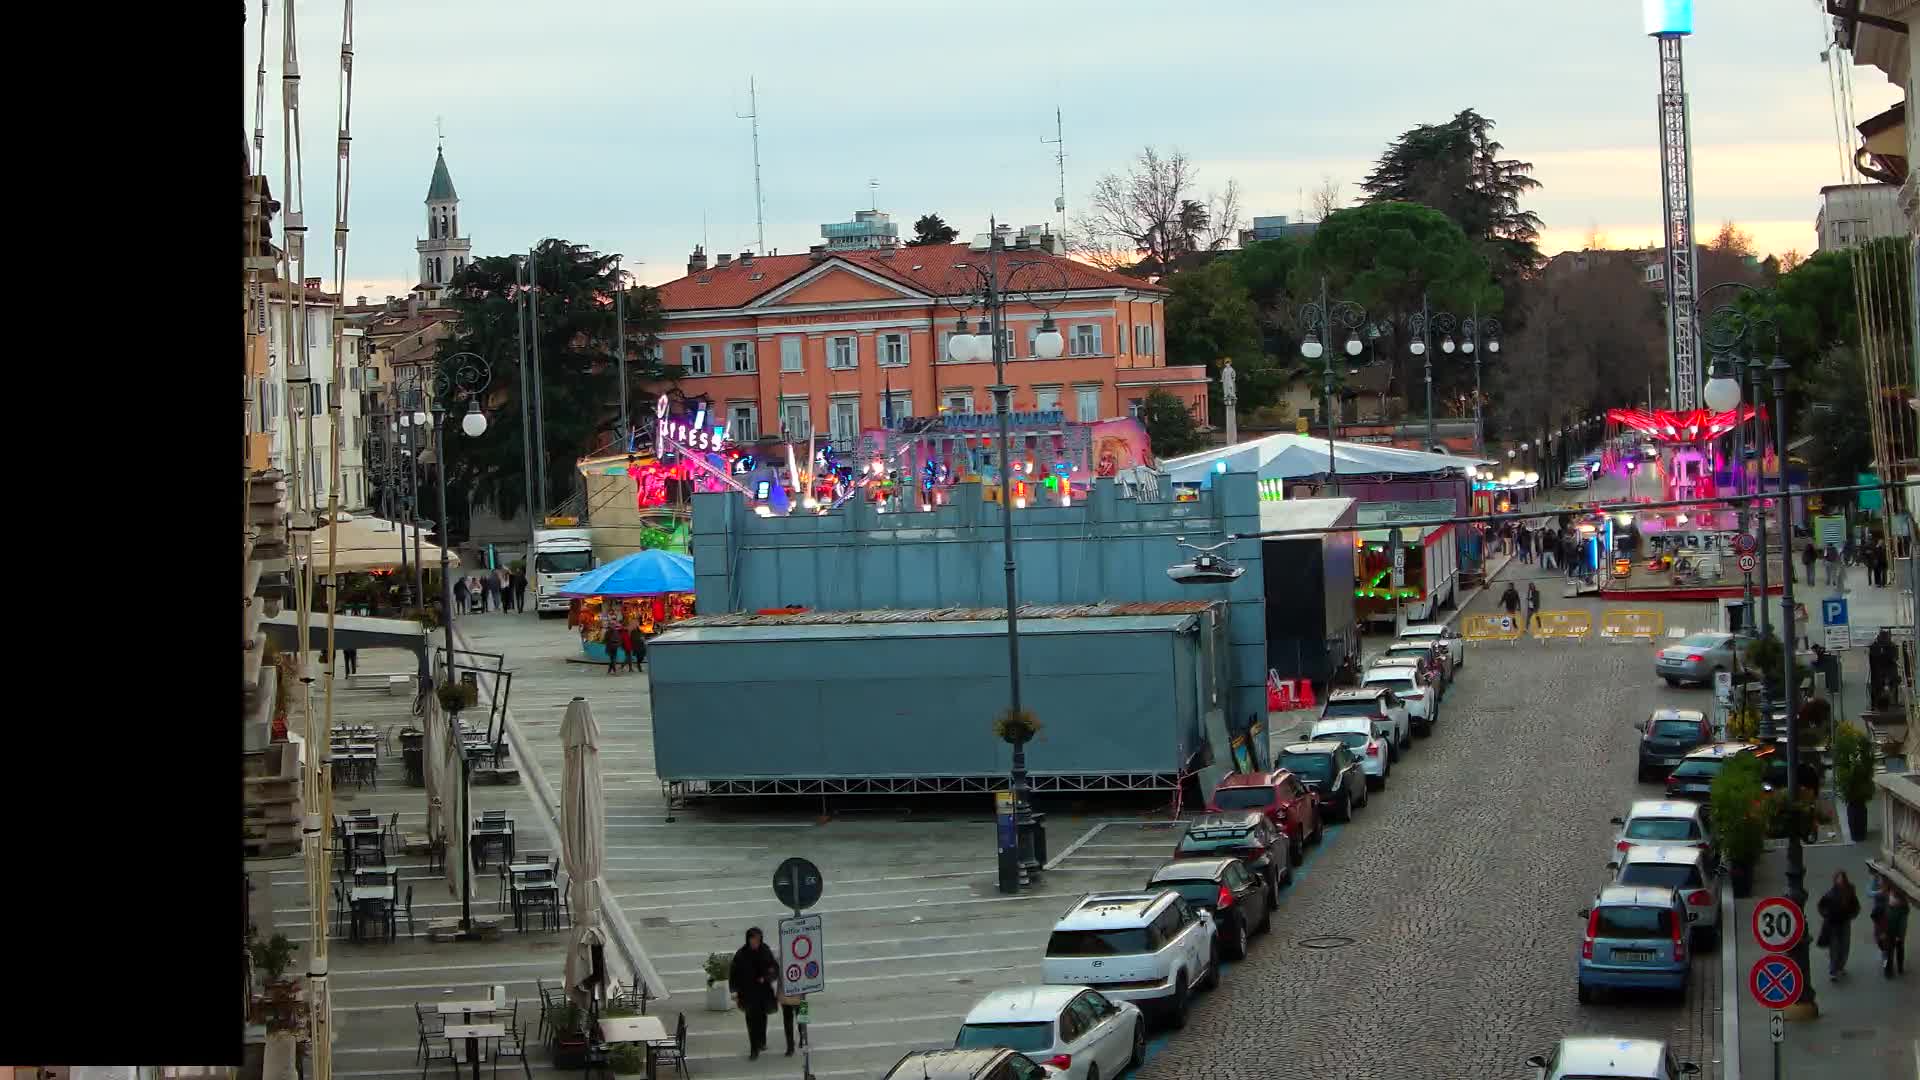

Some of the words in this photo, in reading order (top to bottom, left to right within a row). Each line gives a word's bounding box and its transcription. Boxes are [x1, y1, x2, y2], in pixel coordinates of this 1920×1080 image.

[1742, 558, 1753, 567] 20
[1828, 602, 1842, 622] P
[1762, 912, 1791, 938] 30
